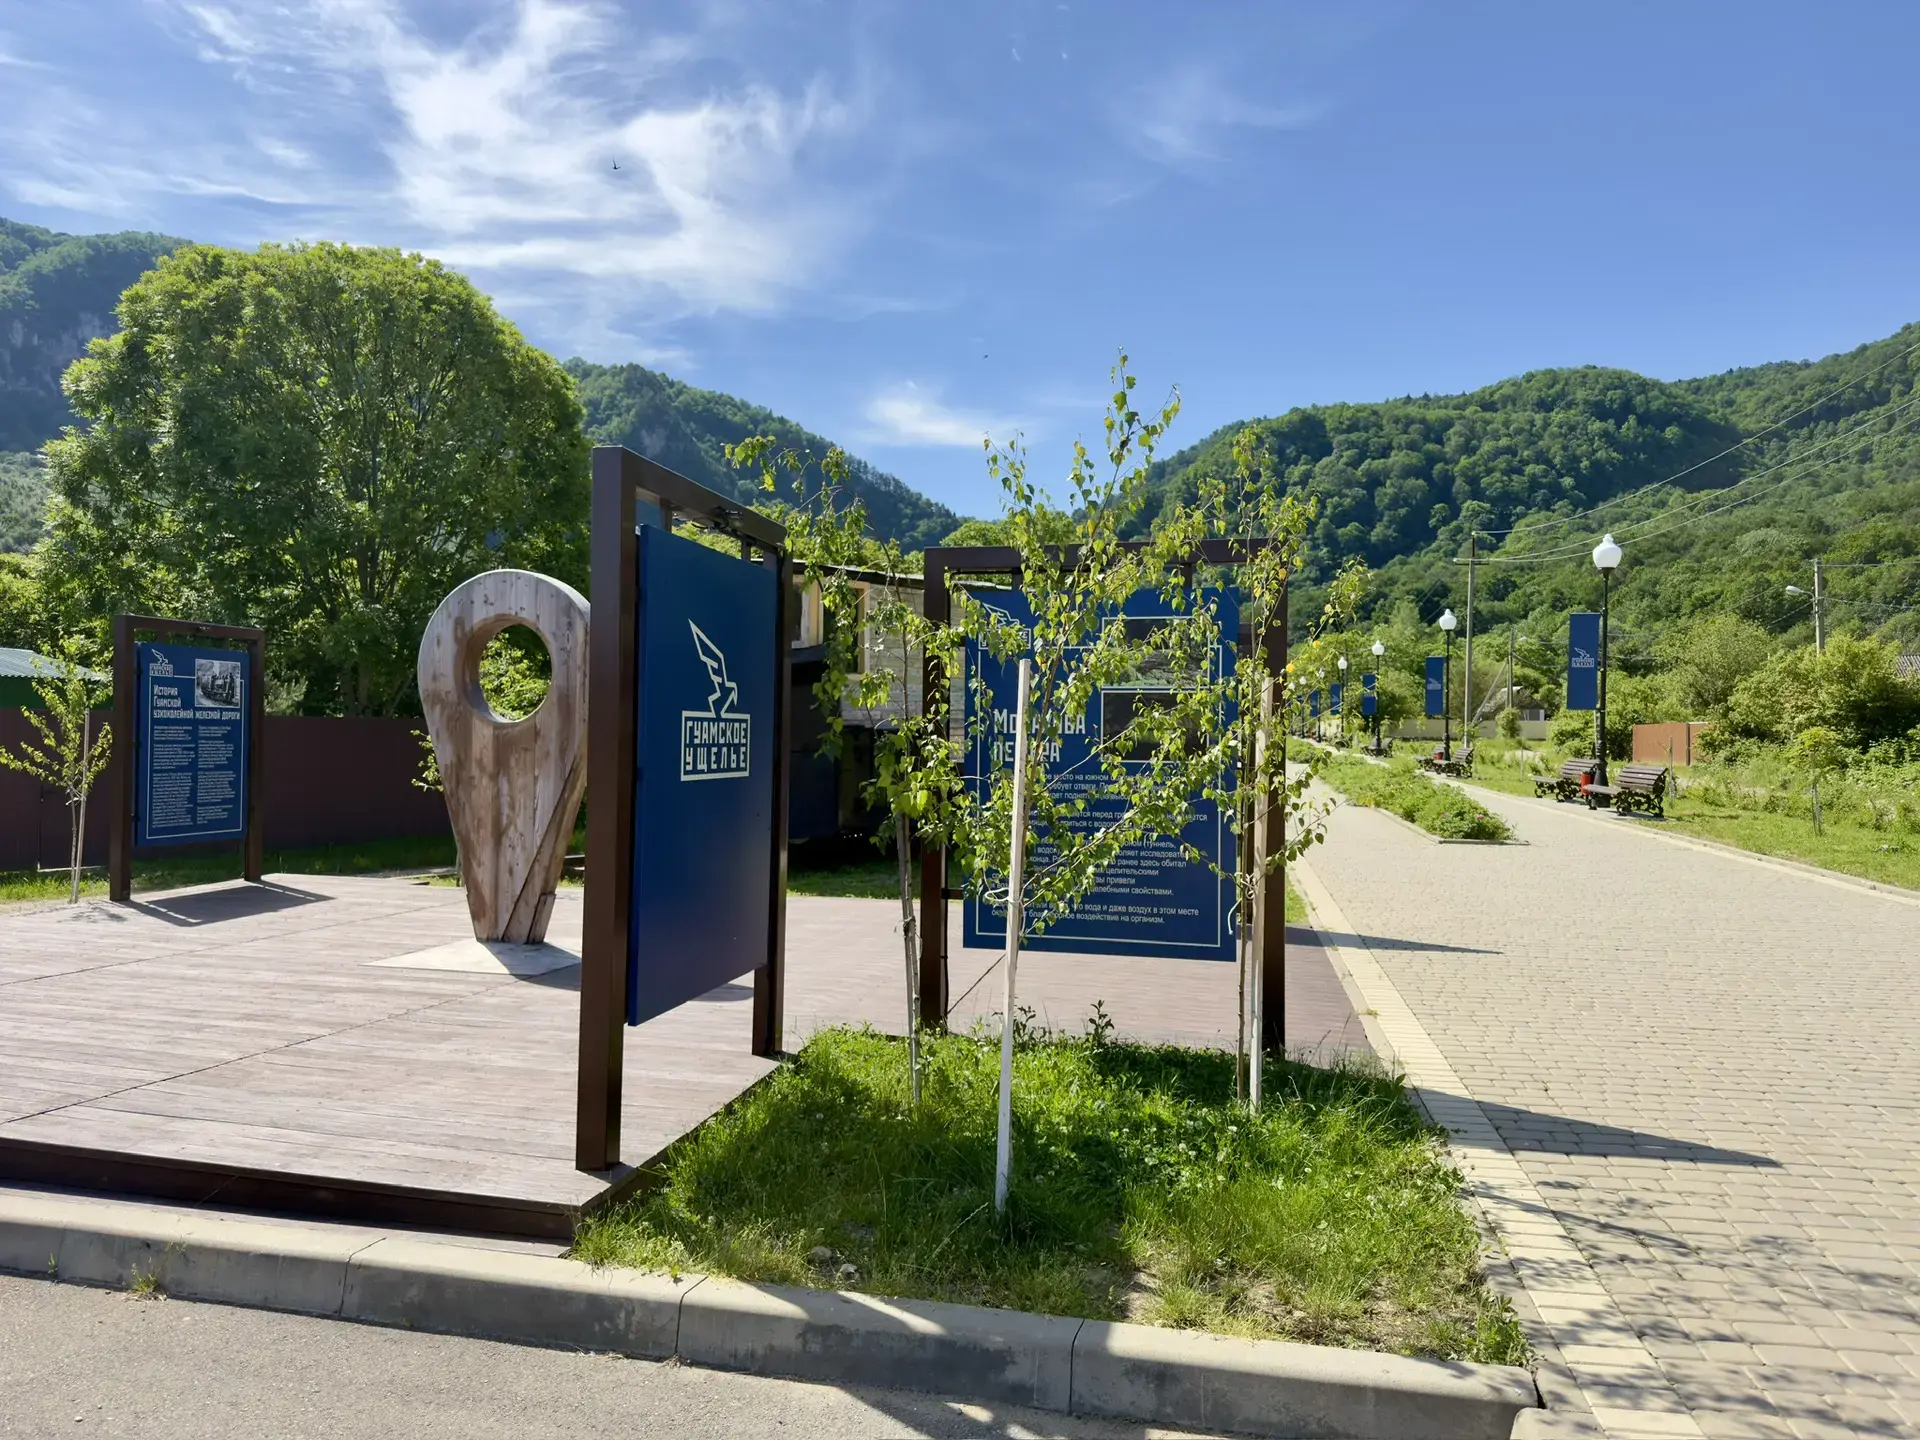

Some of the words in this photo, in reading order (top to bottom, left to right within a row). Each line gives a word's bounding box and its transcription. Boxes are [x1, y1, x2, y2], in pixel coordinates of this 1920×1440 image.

[686, 720, 747, 744] ГУАМСКОЕ
[685, 746, 747, 772] УЩЕЛЬЕ
[1047, 782, 1073, 791] ребует
[1161, 859, 1187, 867] обитал
[1106, 877, 1136, 885] привели
[1131, 887, 1174, 895] свойствами.
[1029, 909, 1075, 919] блаорное
[1076, 912, 1120, 921] воздействие
[1128, 906, 1152, 915] воздух
